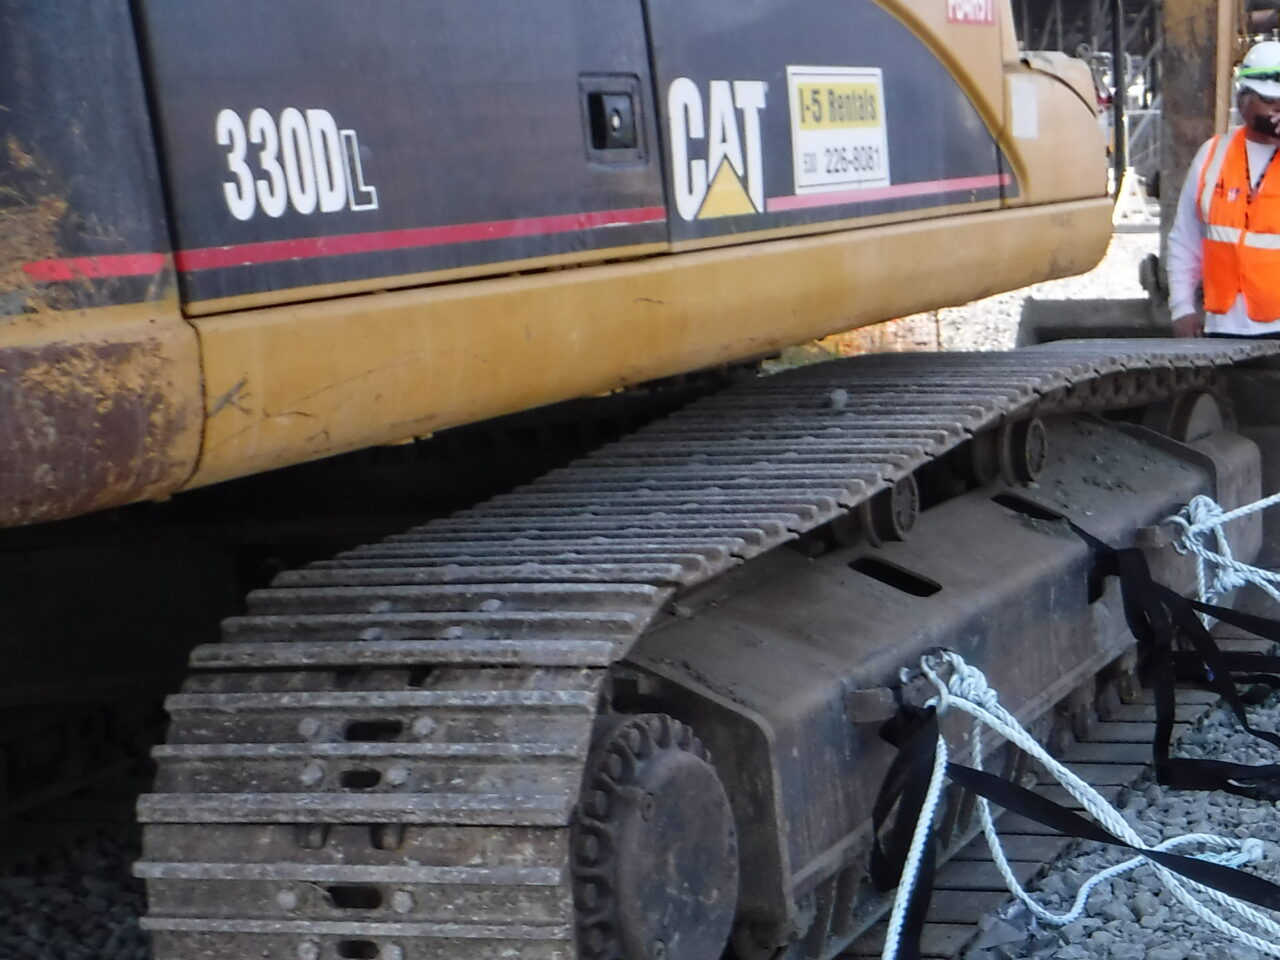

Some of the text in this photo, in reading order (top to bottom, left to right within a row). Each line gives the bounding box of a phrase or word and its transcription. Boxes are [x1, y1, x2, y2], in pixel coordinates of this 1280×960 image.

[668, 77, 767, 221] CAT
[799, 88, 876, 123] I-5 Rentals
[216, 106, 379, 221] 330DL
